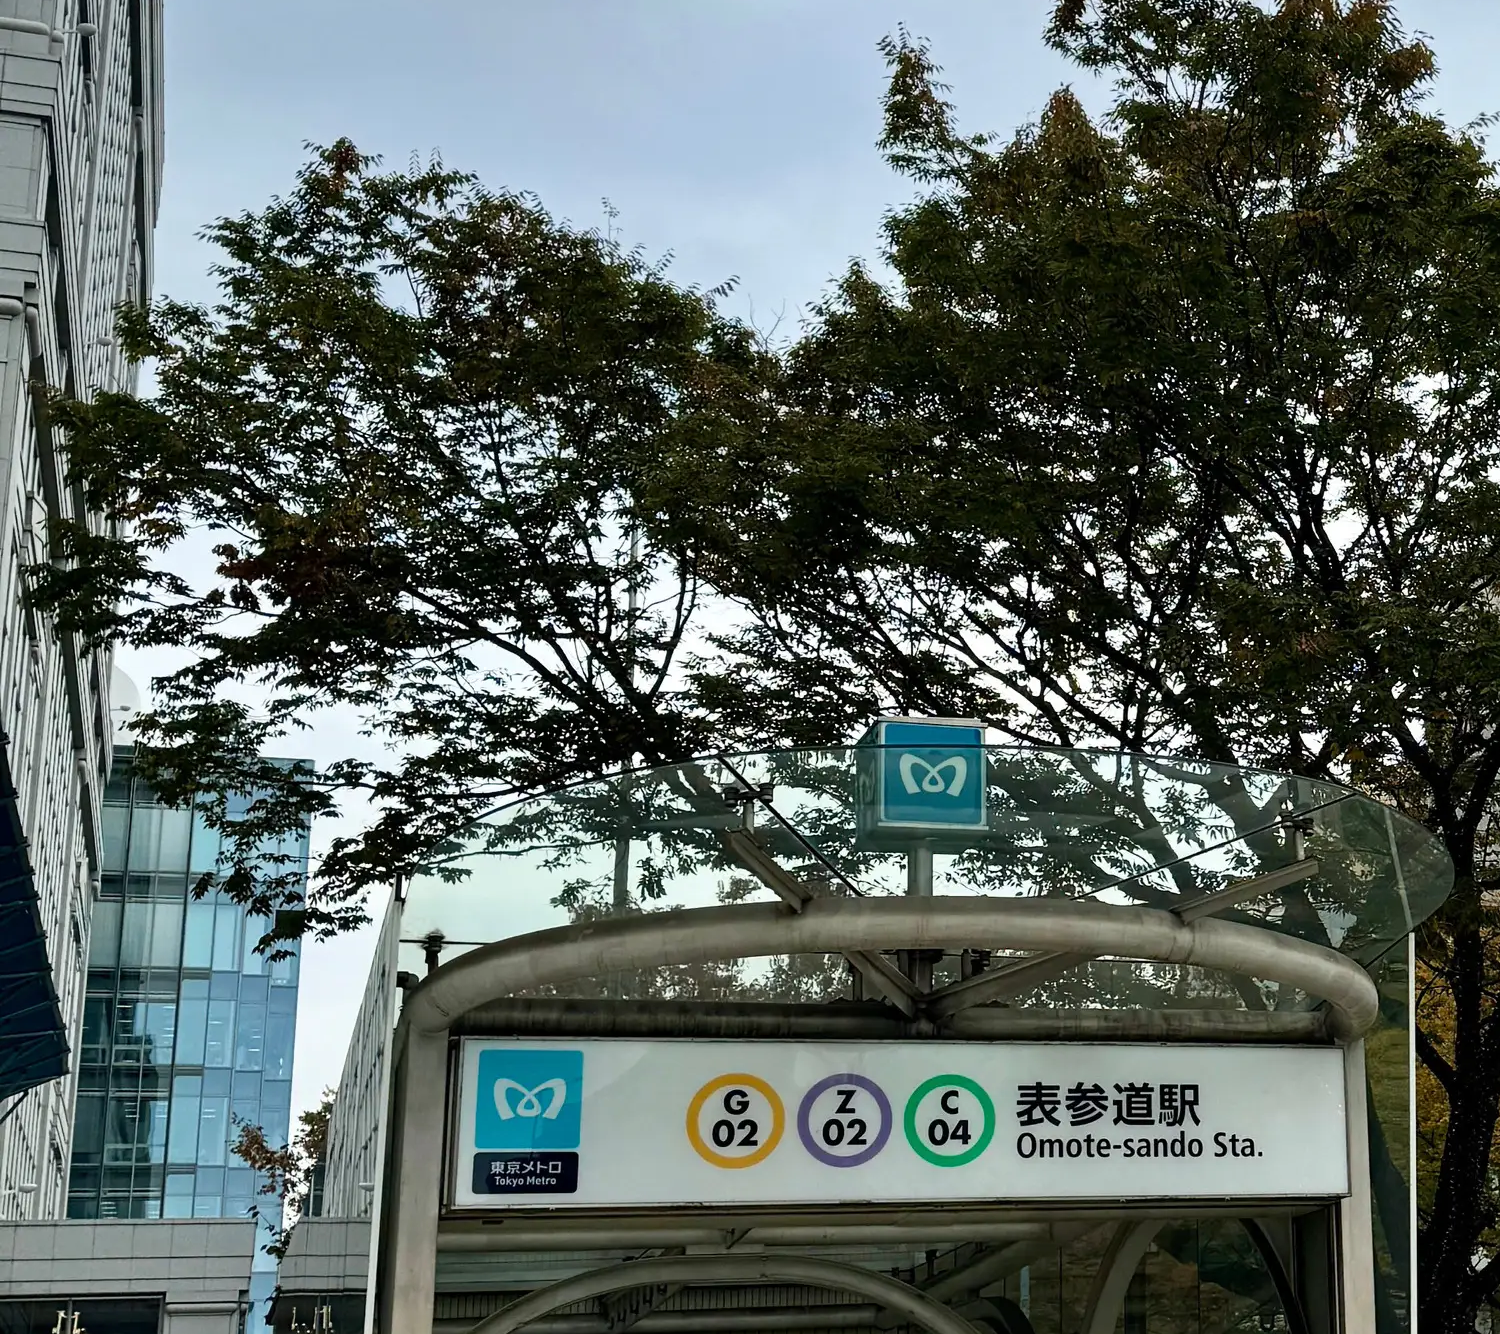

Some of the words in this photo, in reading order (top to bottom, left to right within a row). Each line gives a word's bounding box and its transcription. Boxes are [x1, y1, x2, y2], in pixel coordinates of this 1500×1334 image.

[723, 1089, 750, 1116] G
[834, 1089, 857, 1114] Z
[940, 1089, 959, 1115] C
[1016, 1081, 1201, 1127] 表参道駅
[711, 1119, 759, 1148] 02
[821, 1118, 868, 1147] 02
[927, 1119, 972, 1147] 04
[1016, 1131, 1204, 1159] Omote-sando
[1213, 1131, 1264, 1159] Sta.
[490, 1161, 562, 1175] 東京メトロ
[494, 1175, 525, 1187] Tokyo
[526, 1175, 557, 1186] Metro
